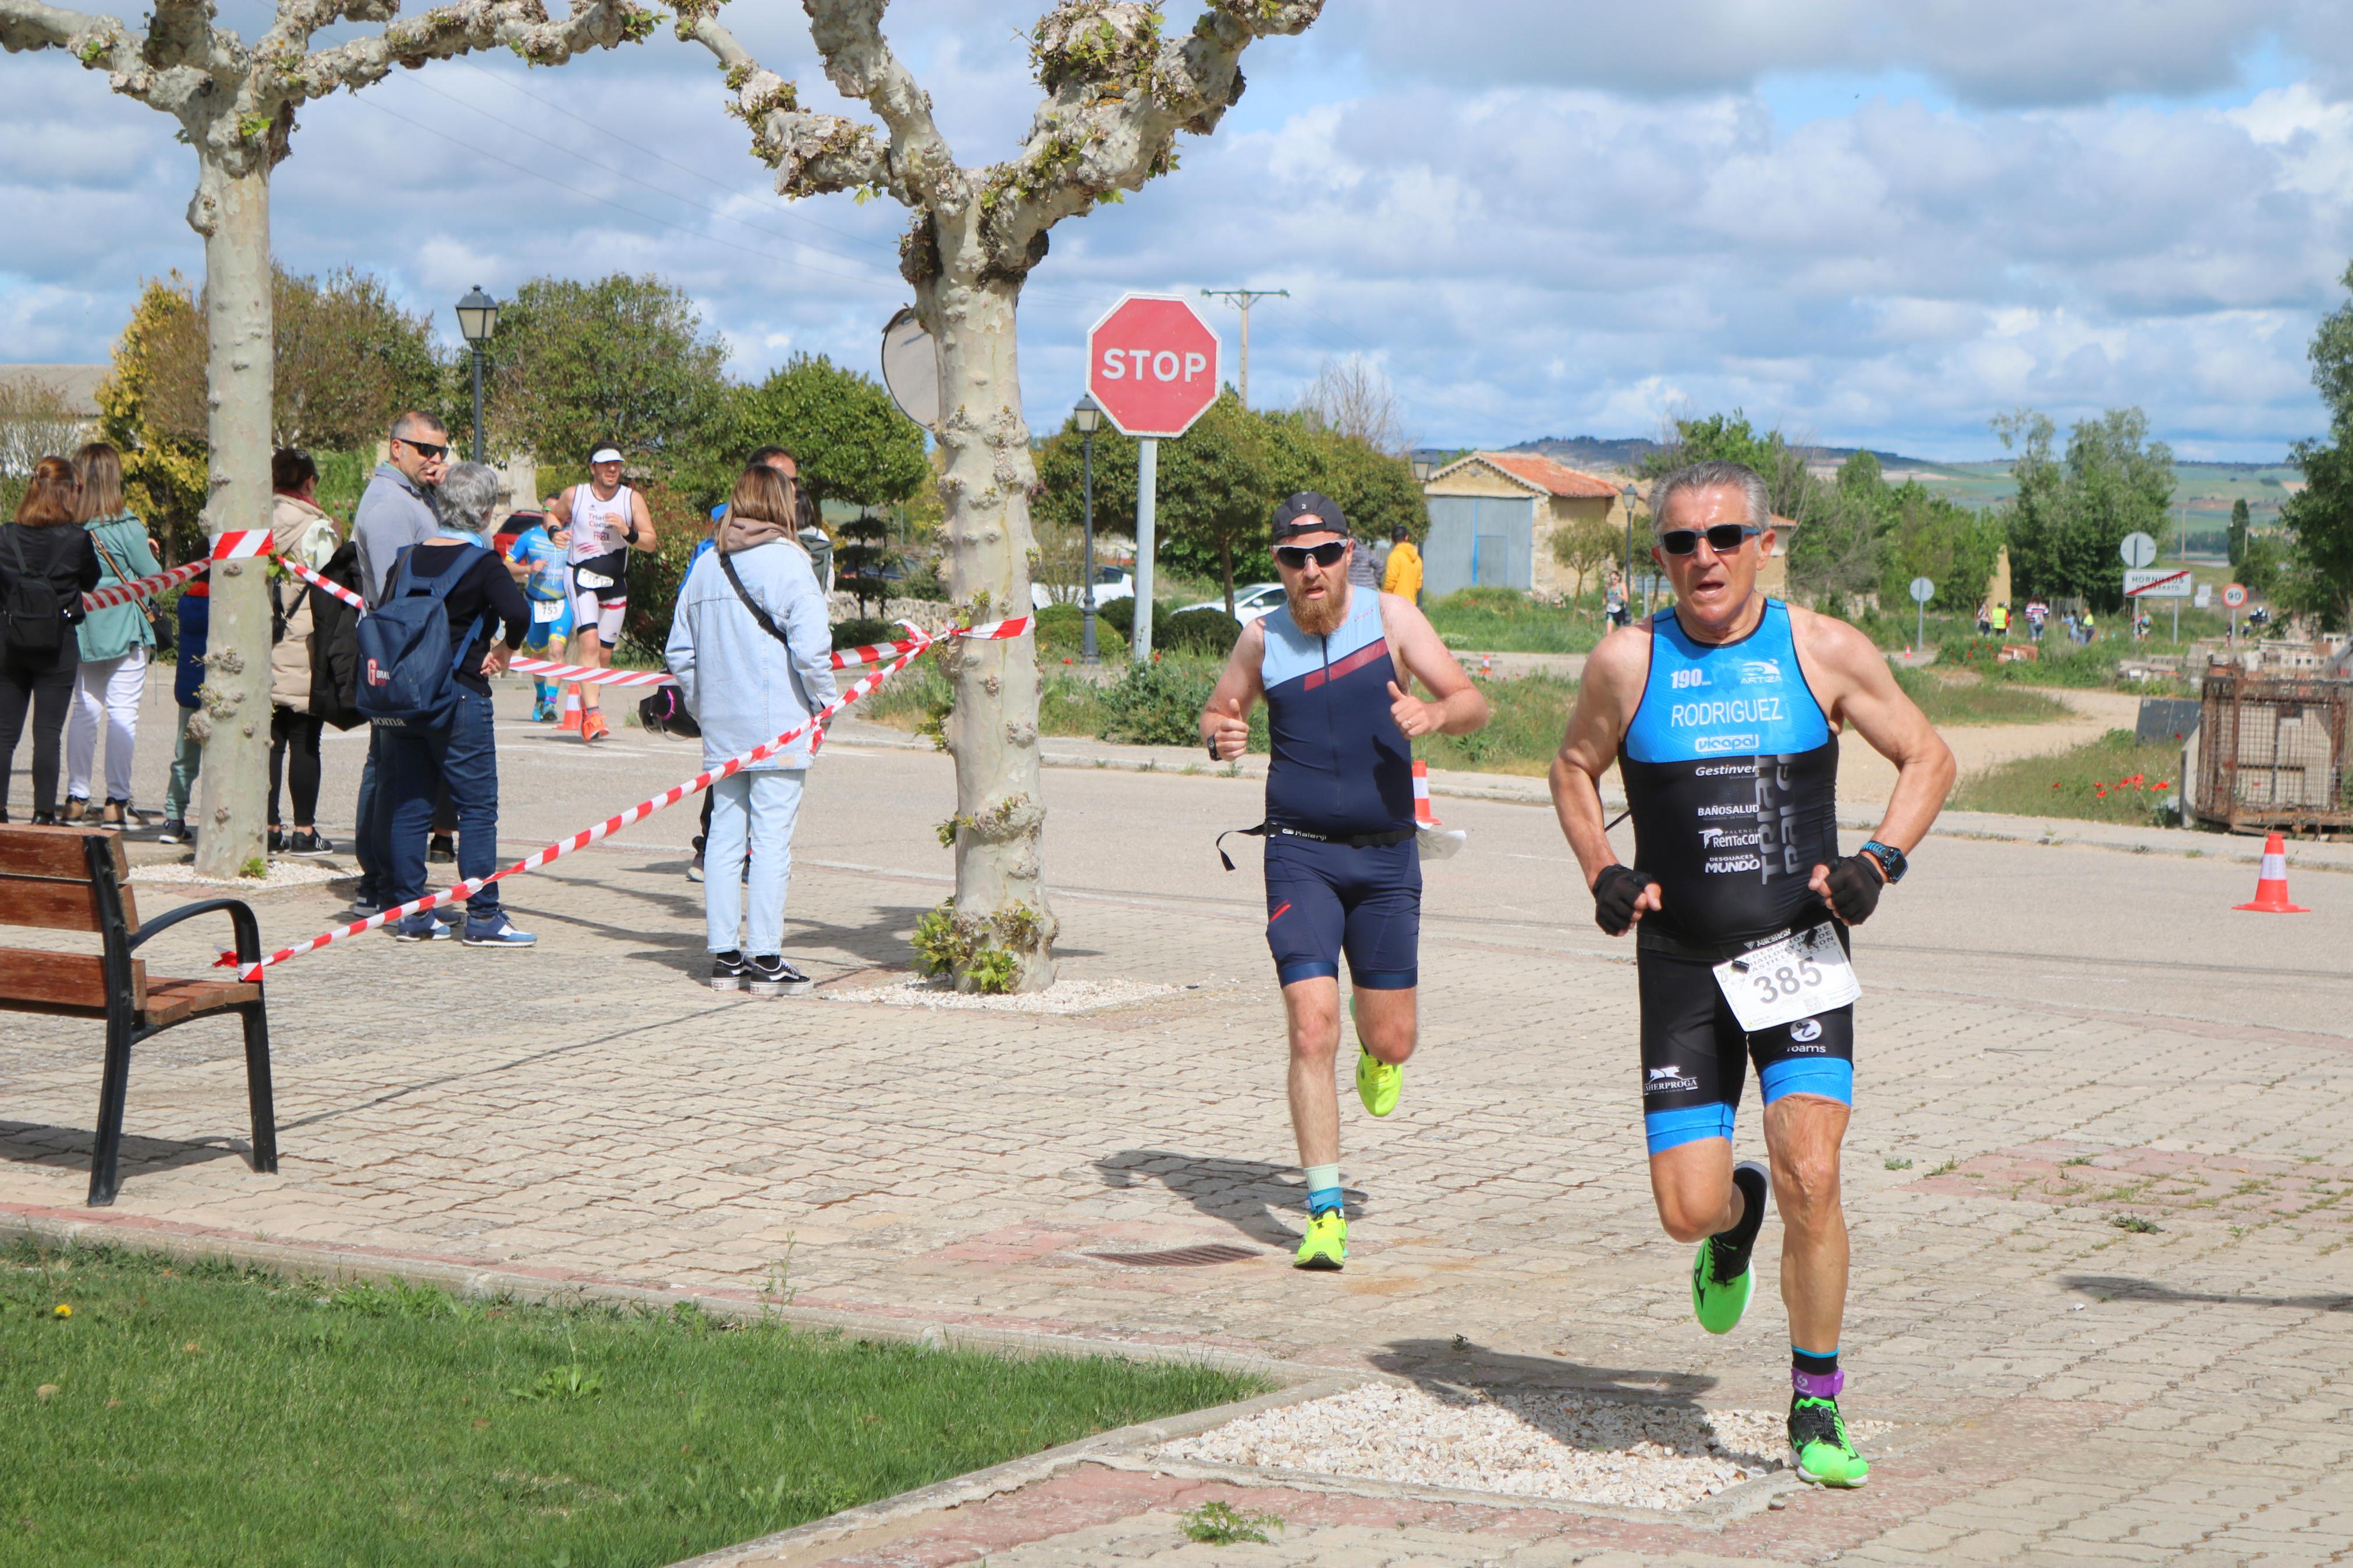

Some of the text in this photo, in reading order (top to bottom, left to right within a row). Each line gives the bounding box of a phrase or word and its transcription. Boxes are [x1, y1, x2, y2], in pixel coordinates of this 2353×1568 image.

[1101, 348, 1207, 383] STOP
[2227, 591, 2242, 601] 90
[542, 606, 558, 615] 753
[1670, 669, 1702, 689] 190
[1741, 675, 1783, 684] ARTIZA
[1671, 698, 1784, 727] RODRIGUEZ
[1695, 765, 1759, 777] Gestinver
[1698, 804, 1760, 817] BAÑOSALUD
[1709, 854, 1754, 862] DESGUACES
[1705, 859, 1761, 873] MUNDO
[1753, 956, 1823, 1005] 385
